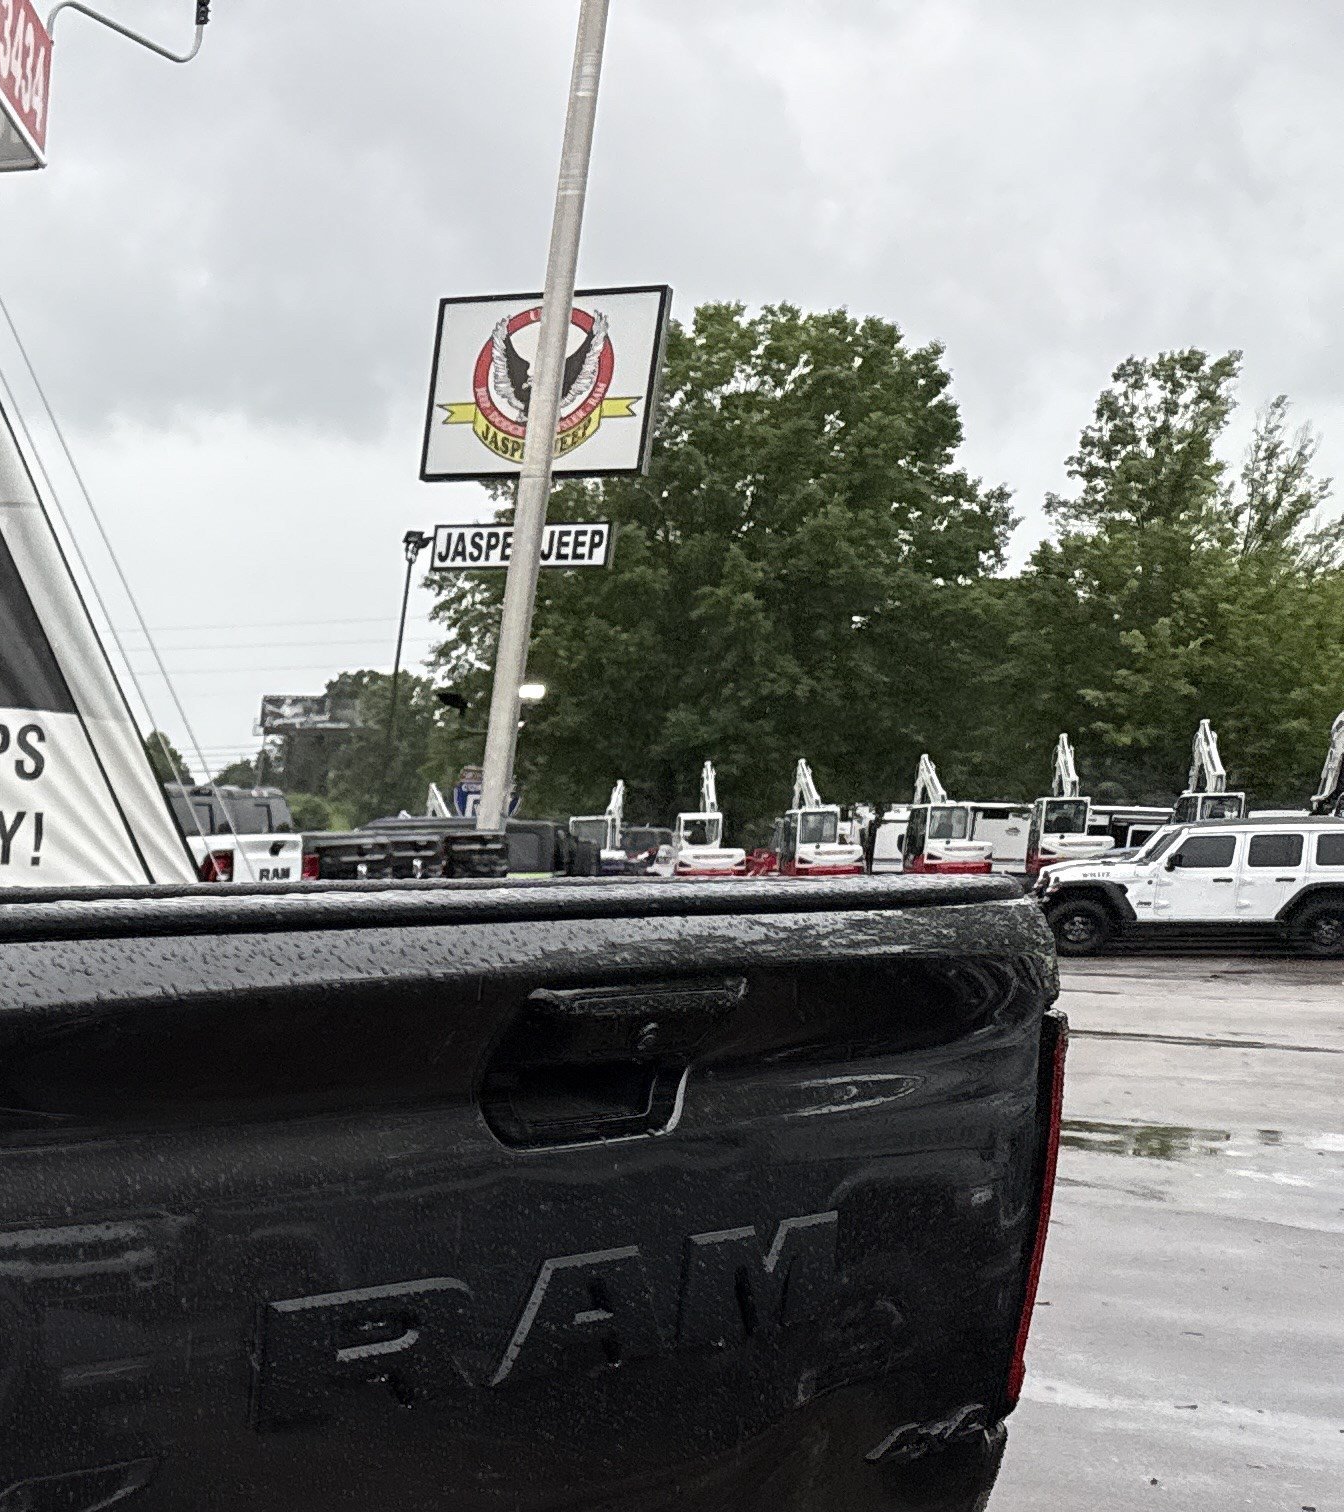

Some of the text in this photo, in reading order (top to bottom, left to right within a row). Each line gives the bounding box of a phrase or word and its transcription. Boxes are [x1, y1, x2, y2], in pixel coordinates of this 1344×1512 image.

[437, 529, 604, 562] JASPE JEEP
[259, 867, 291, 882] RAM
[249, 1208, 840, 1434] RAM
